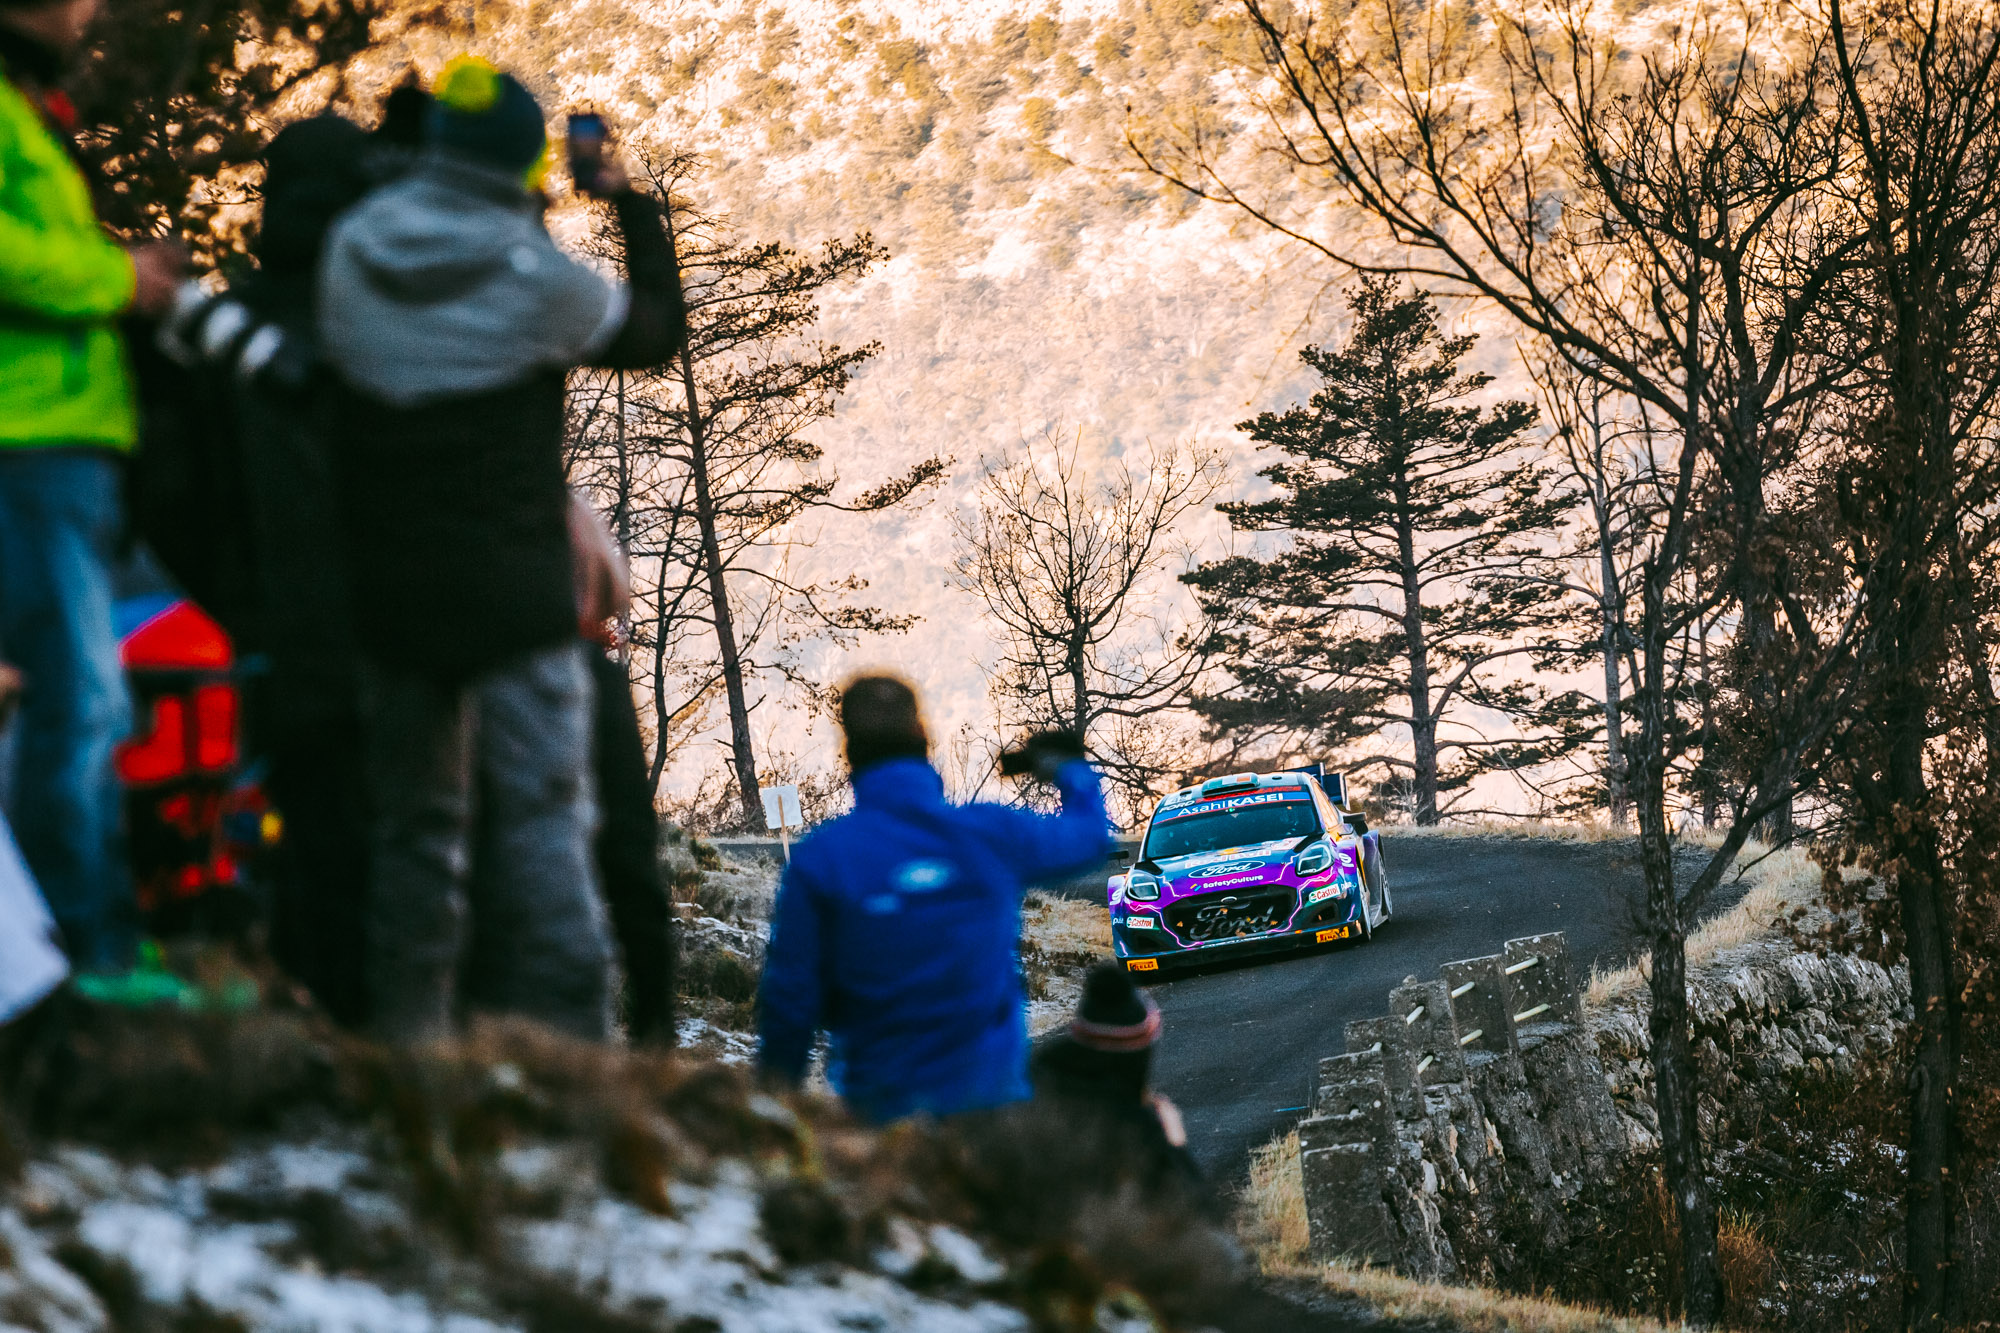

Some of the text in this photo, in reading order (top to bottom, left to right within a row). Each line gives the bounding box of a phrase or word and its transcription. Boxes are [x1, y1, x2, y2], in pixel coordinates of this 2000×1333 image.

[1159, 800, 1195, 813] FORD
[1201, 861, 1252, 877] Ford
[1203, 875, 1264, 889] SafetyCulture
[1316, 886, 1339, 900] Castrol
[1131, 918, 1152, 927] Castrol
[1189, 902, 1274, 941] Ford
